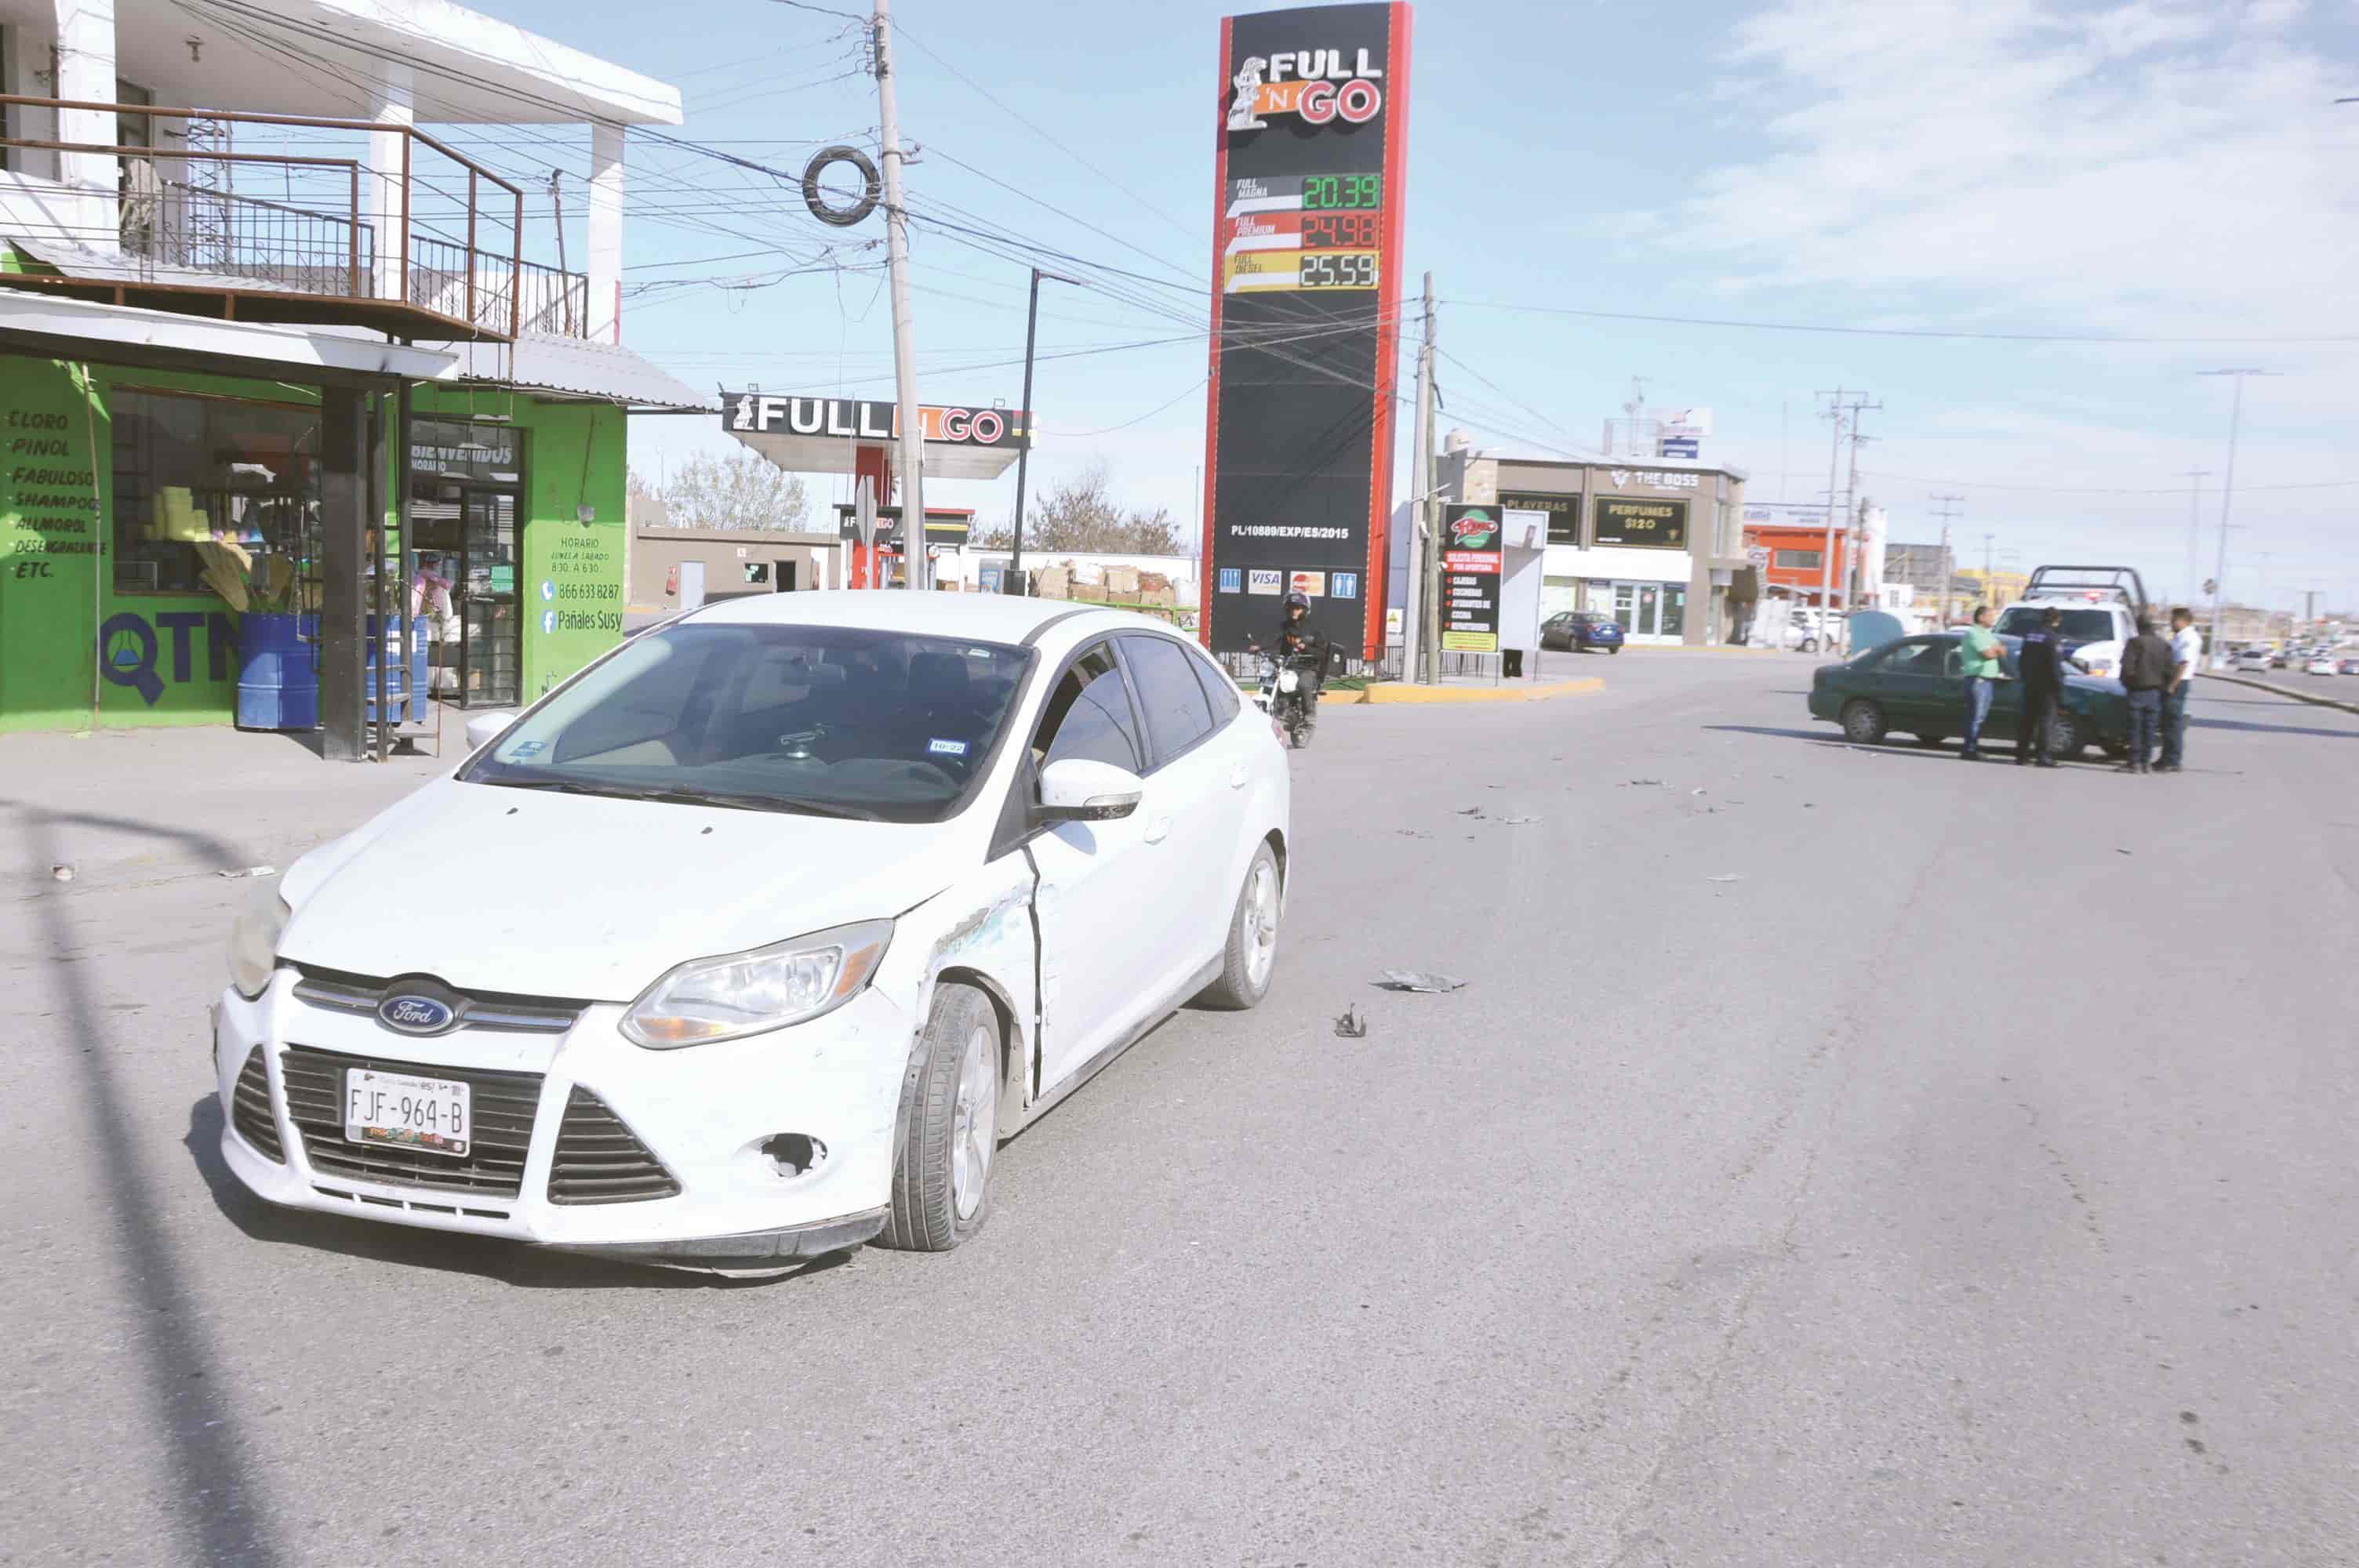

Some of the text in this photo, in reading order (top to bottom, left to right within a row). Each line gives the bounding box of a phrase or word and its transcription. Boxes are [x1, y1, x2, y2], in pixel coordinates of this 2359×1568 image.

[1270, 48, 1382, 82] FULL
[1298, 79, 1380, 124] GO
[1237, 178, 1256, 190] FULL
[1238, 187, 1268, 198] MAGNA
[1304, 176, 1377, 209] 20.39
[1235, 217, 1256, 227] FULL
[1237, 225, 1276, 237] PREMIUM
[1300, 256, 1374, 286] 25.59
[9, 411, 68, 430] CLORO
[758, 397, 889, 438] FULL
[941, 408, 1003, 444] GO
[12, 438, 69, 457] PINOL
[13, 467, 95, 487] FABULOSO
[1634, 470, 1699, 487] THE BOSS
[1506, 499, 1569, 513] PLAYERAS
[1608, 504, 1674, 517] PERFUMES
[1624, 517, 1656, 530] $120
[562, 538, 599, 549] HORARIO
[16, 561, 54, 579] ETC.
[1252, 572, 1280, 584] VISA
[559, 583, 620, 601] 866 633 8287
[558, 609, 623, 633] Pañales Susy
[394, 1000, 434, 1024] Ford
[351, 1088, 463, 1134] FJF-964-B
